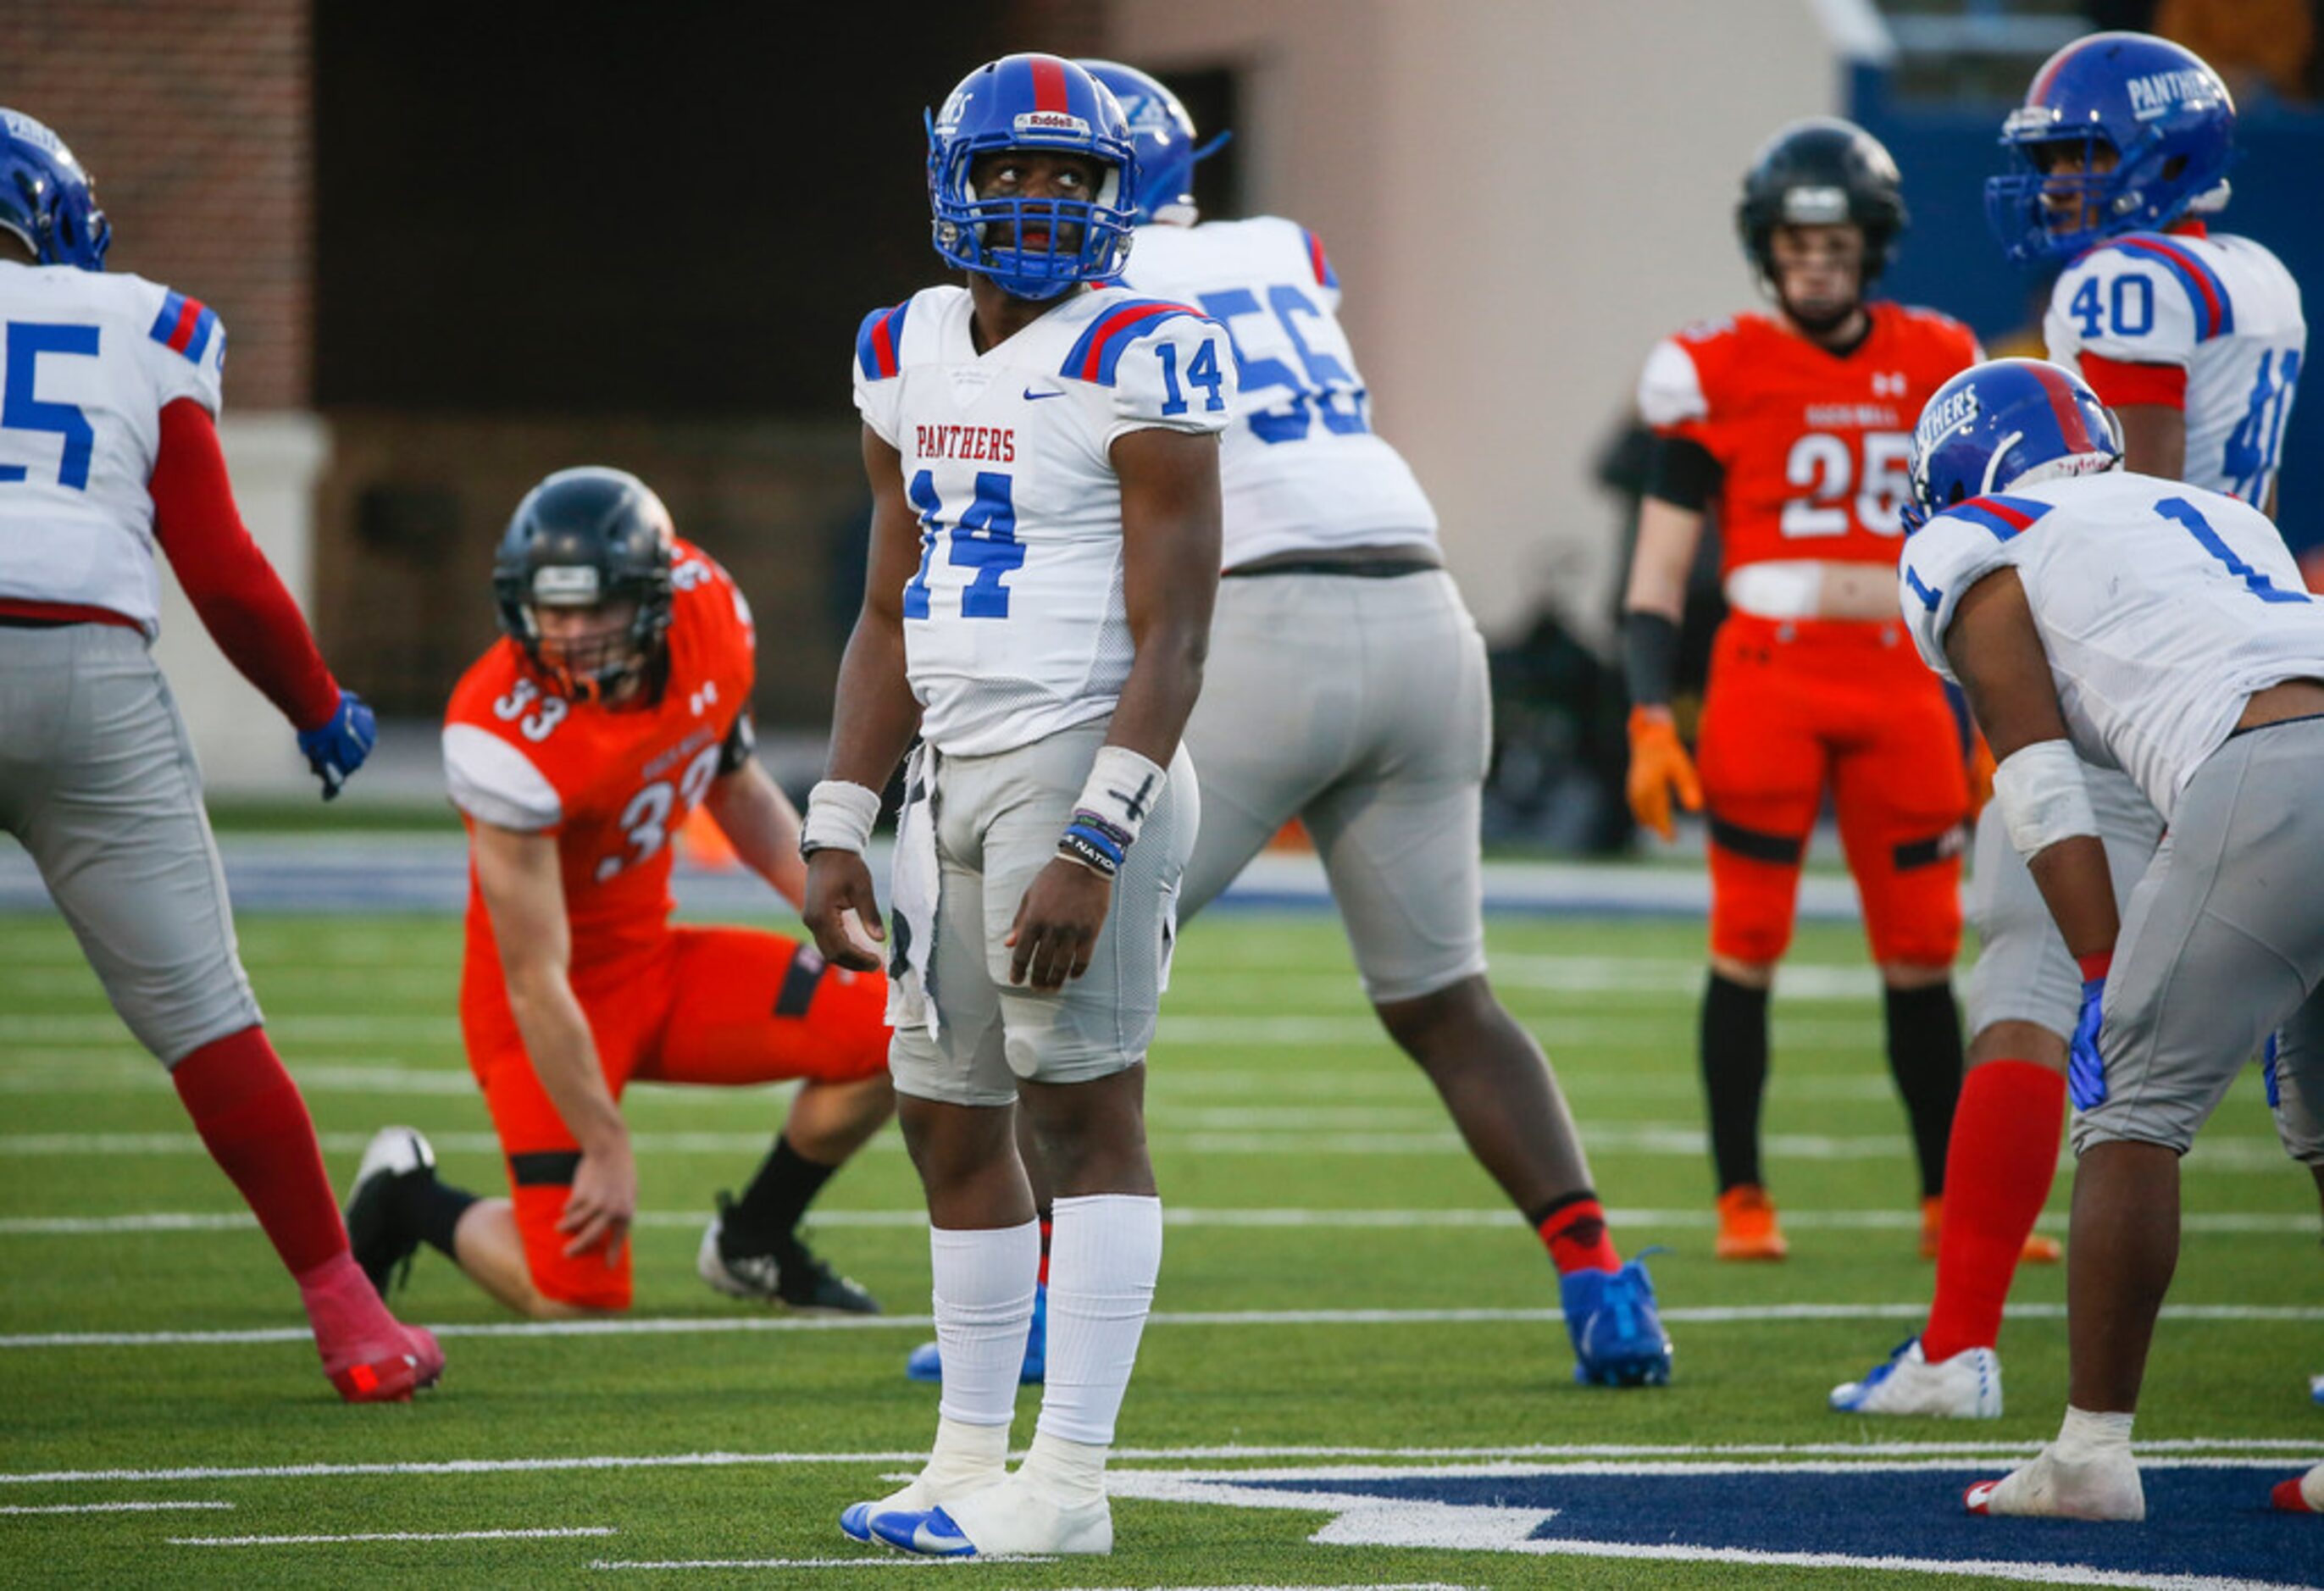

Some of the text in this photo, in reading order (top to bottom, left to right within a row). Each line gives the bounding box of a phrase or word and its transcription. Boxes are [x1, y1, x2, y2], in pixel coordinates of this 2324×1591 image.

[1029, 115, 1073, 127] Riddell
[2070, 274, 2155, 338] 40
[1154, 337, 1225, 415] 14
[1195, 284, 1369, 446] 56
[916, 424, 1015, 462] PANTHERS
[1781, 430, 1911, 539] 25
[903, 468, 1027, 619] 14
[2154, 496, 2313, 603] 1
[1905, 563, 1944, 613] 1
[493, 677, 569, 742] 33
